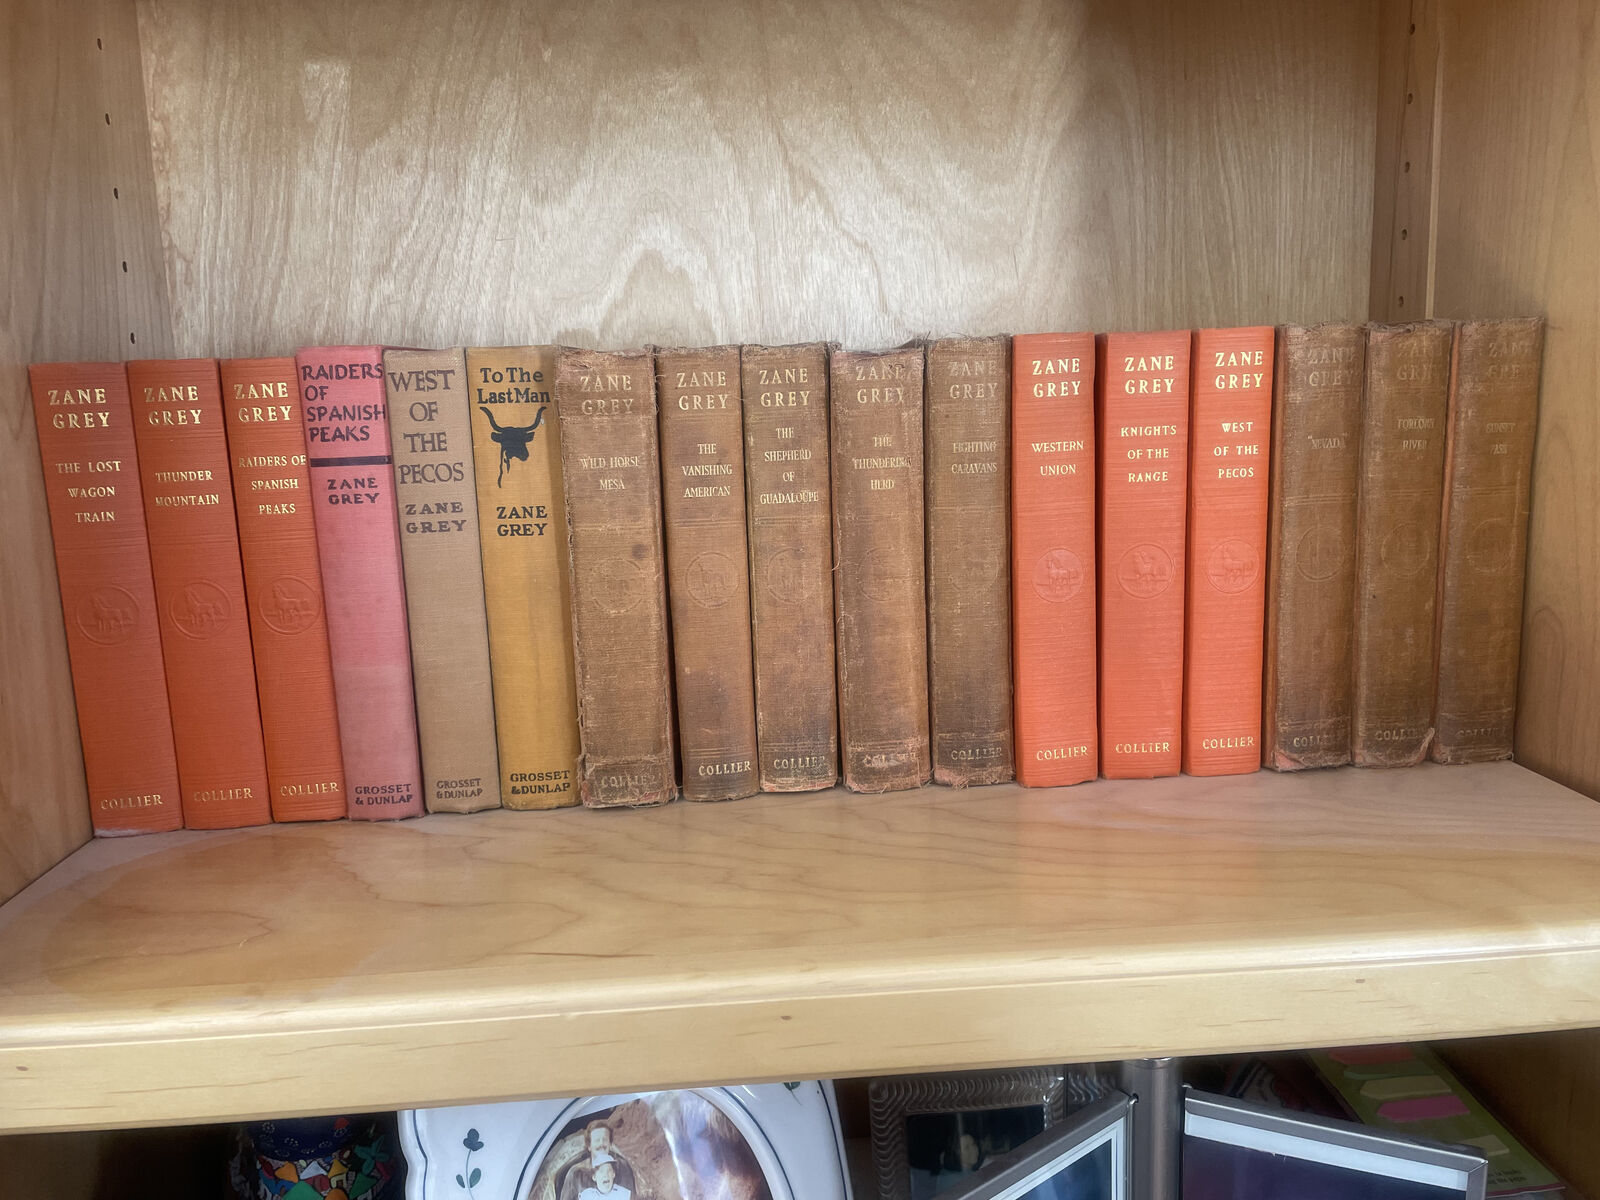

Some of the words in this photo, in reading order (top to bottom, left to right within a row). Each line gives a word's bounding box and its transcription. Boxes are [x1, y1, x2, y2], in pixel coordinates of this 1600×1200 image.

[1124, 355, 1174, 372] ZANE
[1215, 351, 1264, 367] ZANE
[301, 363, 383, 381] RAIDERS
[856, 364, 905, 381] ZANE
[949, 361, 996, 377] ZANE
[1032, 358, 1080, 375] ZANE
[388, 369, 455, 392] WEST
[480, 367, 503, 383] To
[506, 367, 544, 383] The
[677, 371, 726, 388] ZANE
[759, 368, 808, 385] ZANE
[1215, 373, 1264, 389] GREY
[580, 375, 632, 392] ZANE
[1033, 381, 1081, 398] GREY
[1125, 378, 1175, 394] GREY
[48, 388, 106, 405] ZANE
[144, 386, 199, 403] ZANE
[234, 382, 289, 400] ZANE
[304, 385, 329, 401] OF
[477, 388, 513, 404] Last
[514, 387, 550, 403] Man
[857, 387, 904, 404] GREY
[950, 383, 997, 399] GREY
[678, 394, 728, 411] GREY
[760, 390, 810, 407] GREY
[238, 405, 292, 423] GREY
[306, 404, 386, 422] SPANISH
[409, 401, 438, 422] OF
[581, 398, 634, 416] GREY
[53, 412, 110, 429] GREY
[149, 409, 202, 426] GREY
[308, 425, 370, 442] PEAKS
[776, 427, 794, 439] THE
[1121, 425, 1177, 437] KNIGHTS
[1221, 421, 1254, 433] WEST
[403, 431, 447, 453] THE
[873, 435, 892, 447] THE
[952, 441, 997, 454] FIGHTING
[1032, 440, 1084, 453] WESTERN
[698, 443, 717, 455] THE
[764, 449, 812, 462] SHEPHERD
[1127, 449, 1143, 460] OF
[1147, 448, 1169, 459] THE
[1213, 446, 1229, 457] OF
[1236, 444, 1259, 456] THE
[55, 462, 80, 474] THE
[88, 460, 121, 473] LOST
[239, 455, 288, 468] RAIDERS
[291, 454, 306, 466] OF
[580, 457, 606, 470] WILD
[398, 461, 464, 484] PECOS
[682, 464, 733, 476] VANISHING
[951, 462, 997, 475] CARAVANS
[1040, 464, 1076, 476] UNION
[1218, 467, 1254, 479] PECOS
[155, 470, 213, 483] THUNDER
[327, 477, 378, 490] ZANE
[783, 471, 795, 482] OF
[1128, 471, 1169, 483] RANGE
[251, 478, 299, 491] SPANISH
[600, 479, 625, 490] MESA
[870, 478, 895, 490] HERD
[68, 486, 115, 498] WAGON
[328, 492, 380, 505] GREY
[684, 486, 731, 498] AMERICAN
[760, 491, 819, 505] GUADALOUPE
[155, 494, 219, 507] MOUNTAIN
[259, 503, 296, 515] PEAKS
[405, 502, 463, 516] ZANE
[496, 505, 548, 519] ZANE
[75, 511, 115, 523] TRAIN
[406, 519, 466, 534] GREY
[497, 522, 548, 536] GREY
[1115, 741, 1170, 754] COLLIER
[1202, 736, 1255, 750] COLLIER
[950, 747, 1002, 761] COLLIER
[1036, 745, 1088, 761] COLLIER
[698, 760, 752, 776] COLLIER
[773, 755, 826, 770] COLLIER
[510, 770, 570, 782] GROSSET
[280, 781, 339, 797] COLLIER
[355, 783, 411, 795] GROSSET
[436, 778, 481, 790] GROSSET
[194, 787, 253, 802] COLLIER
[367, 794, 413, 806] DUNLAP
[101, 794, 163, 810] COLLIER
